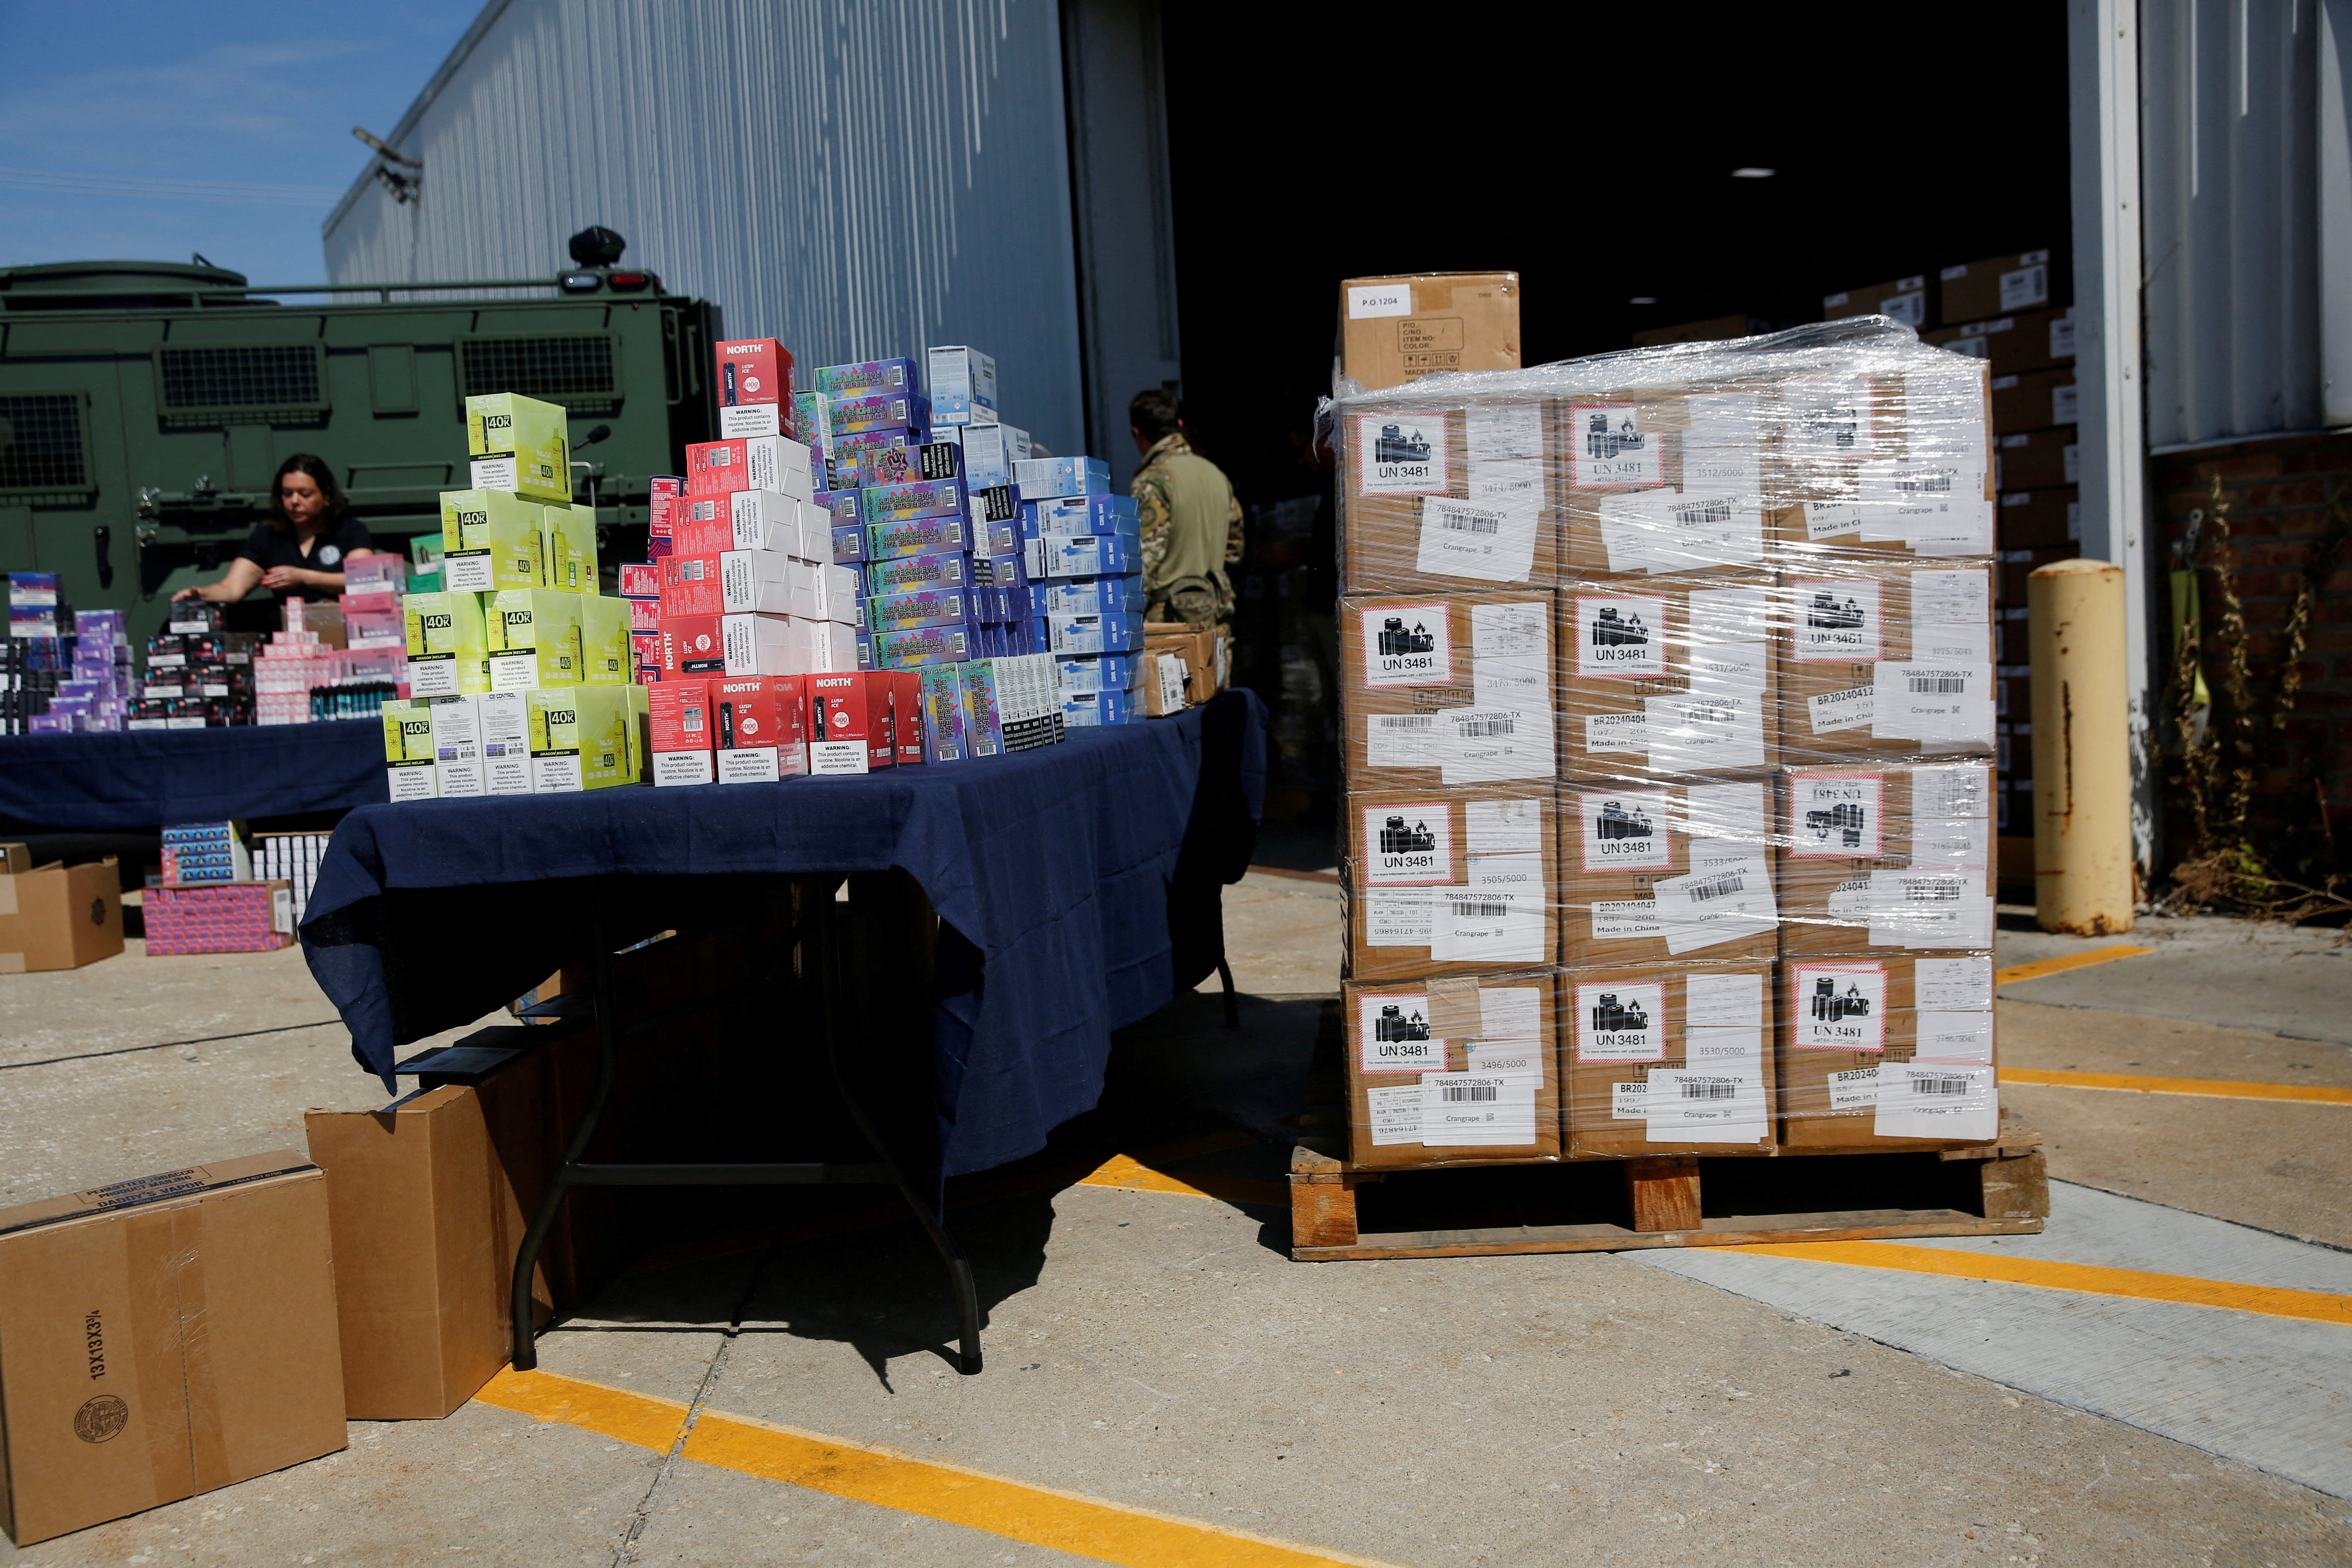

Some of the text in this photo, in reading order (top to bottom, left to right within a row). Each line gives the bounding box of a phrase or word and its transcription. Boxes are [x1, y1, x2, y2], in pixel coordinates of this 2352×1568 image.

[727, 344, 764, 354] NORTH
[489, 416, 510, 428] 40K
[1379, 466, 1429, 478] UN 3481
[1594, 463, 1641, 474] UN 3481
[1482, 481, 1530, 492] 3474/5000
[878, 492, 933, 504] PHENOMENON
[893, 499, 935, 510] EXPERIENCE
[1667, 497, 1737, 512] 784847572806-TX
[1437, 505, 1507, 519] 784847572806-TX
[464, 512, 486, 524] 40K
[1813, 523, 1838, 533] Made
[1443, 543, 1477, 553] Crangrape
[508, 612, 531, 624] 40K
[1811, 633, 1862, 644] UN 3481
[664, 631, 674, 670] NORTH
[1596, 650, 1646, 660] UN 3481
[1383, 657, 1433, 670] UN 3481
[723, 682, 762, 693] NORTH
[816, 678, 853, 688] NORTH
[1488, 678, 1536, 688] 3473/5000
[976, 674, 991, 732] PHENOMENON
[552, 712, 574, 723] 40K
[970, 689, 984, 735] EXPERIENCE
[1451, 711, 1521, 723] 784847572806-TX
[407, 722, 428, 734] 40K
[1818, 719, 1842, 727] Made
[1813, 790, 1861, 799] UN 3481
[1601, 842, 1651, 853] UN 3481
[1384, 856, 1433, 867] UN 3481
[1481, 874, 1527, 884] 3505/5000
[1680, 867, 1748, 890] 784847572806-TX
[1814, 1026, 1862, 1037] UN 3481
[1596, 1035, 1646, 1045] UN 3481
[1379, 1046, 1428, 1056] UN 3481
[1481, 1060, 1526, 1069] 3496/5000
[87, 1169, 195, 1196] PERMITTED TOBACCO
[98, 1175, 192, 1198] PRODUCT MAILING
[98, 1180, 204, 1207] DADDY'S VAPOR
